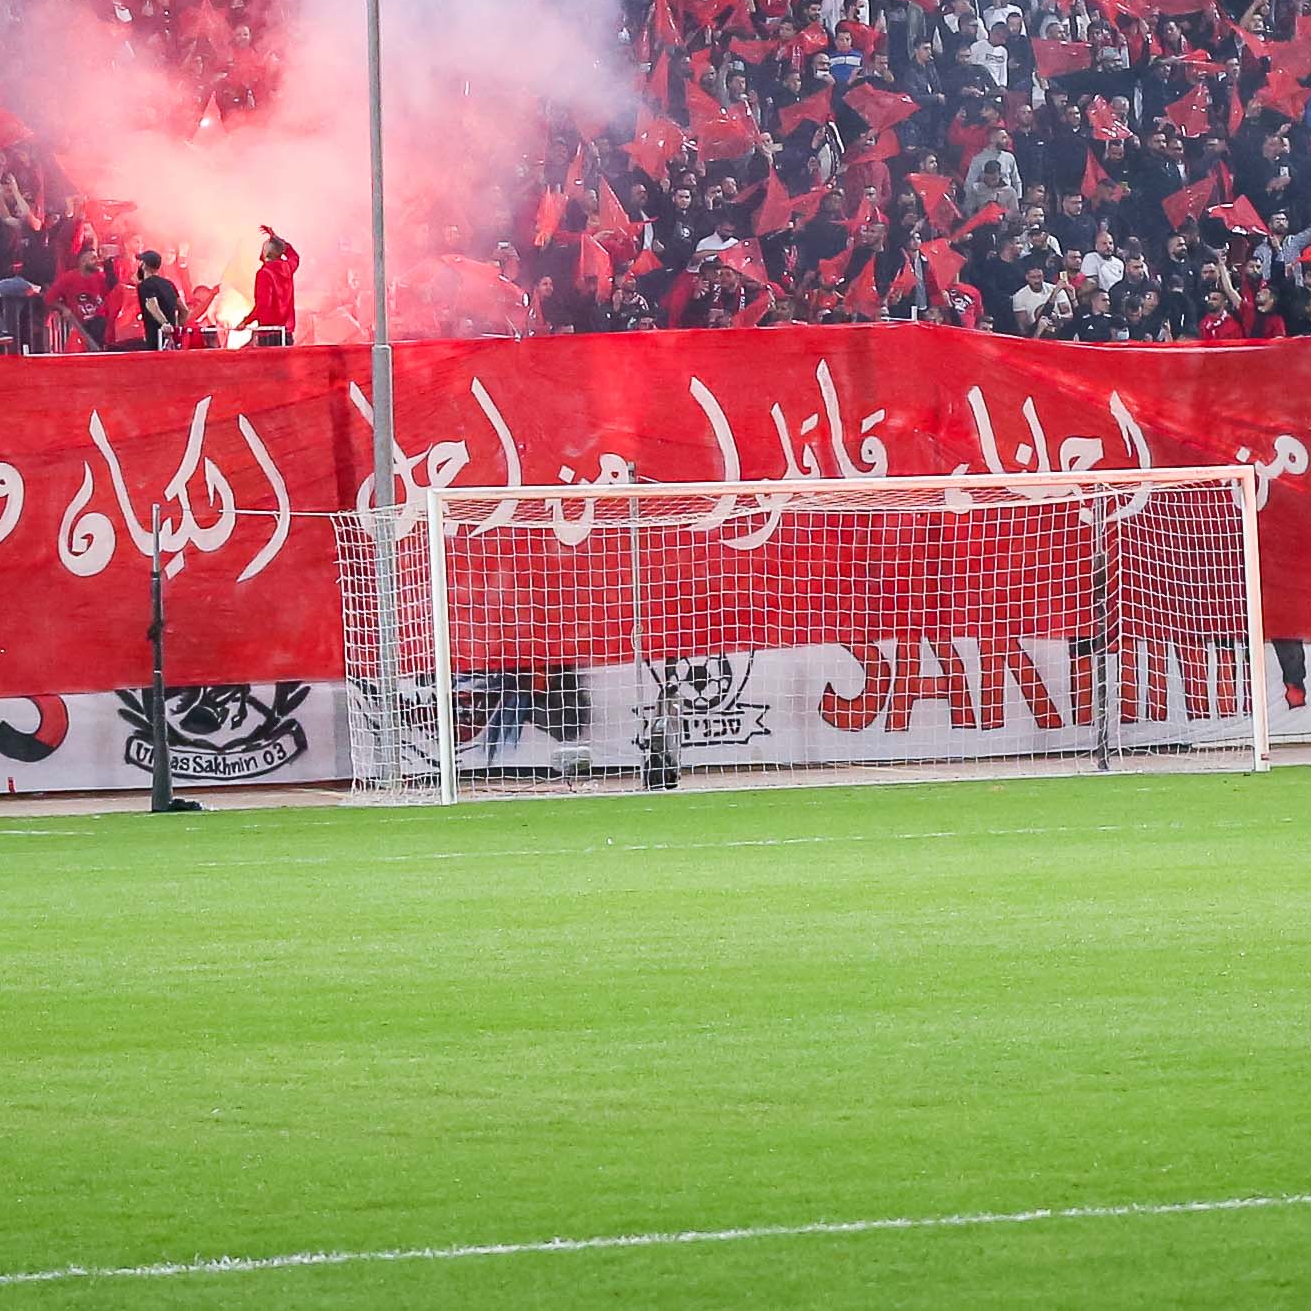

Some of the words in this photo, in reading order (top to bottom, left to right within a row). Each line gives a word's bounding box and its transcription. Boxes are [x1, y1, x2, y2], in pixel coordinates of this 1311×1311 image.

[135, 741, 190, 772] Ulas
[193, 750, 258, 776] Sakhnin
[262, 742, 287, 766] 03
